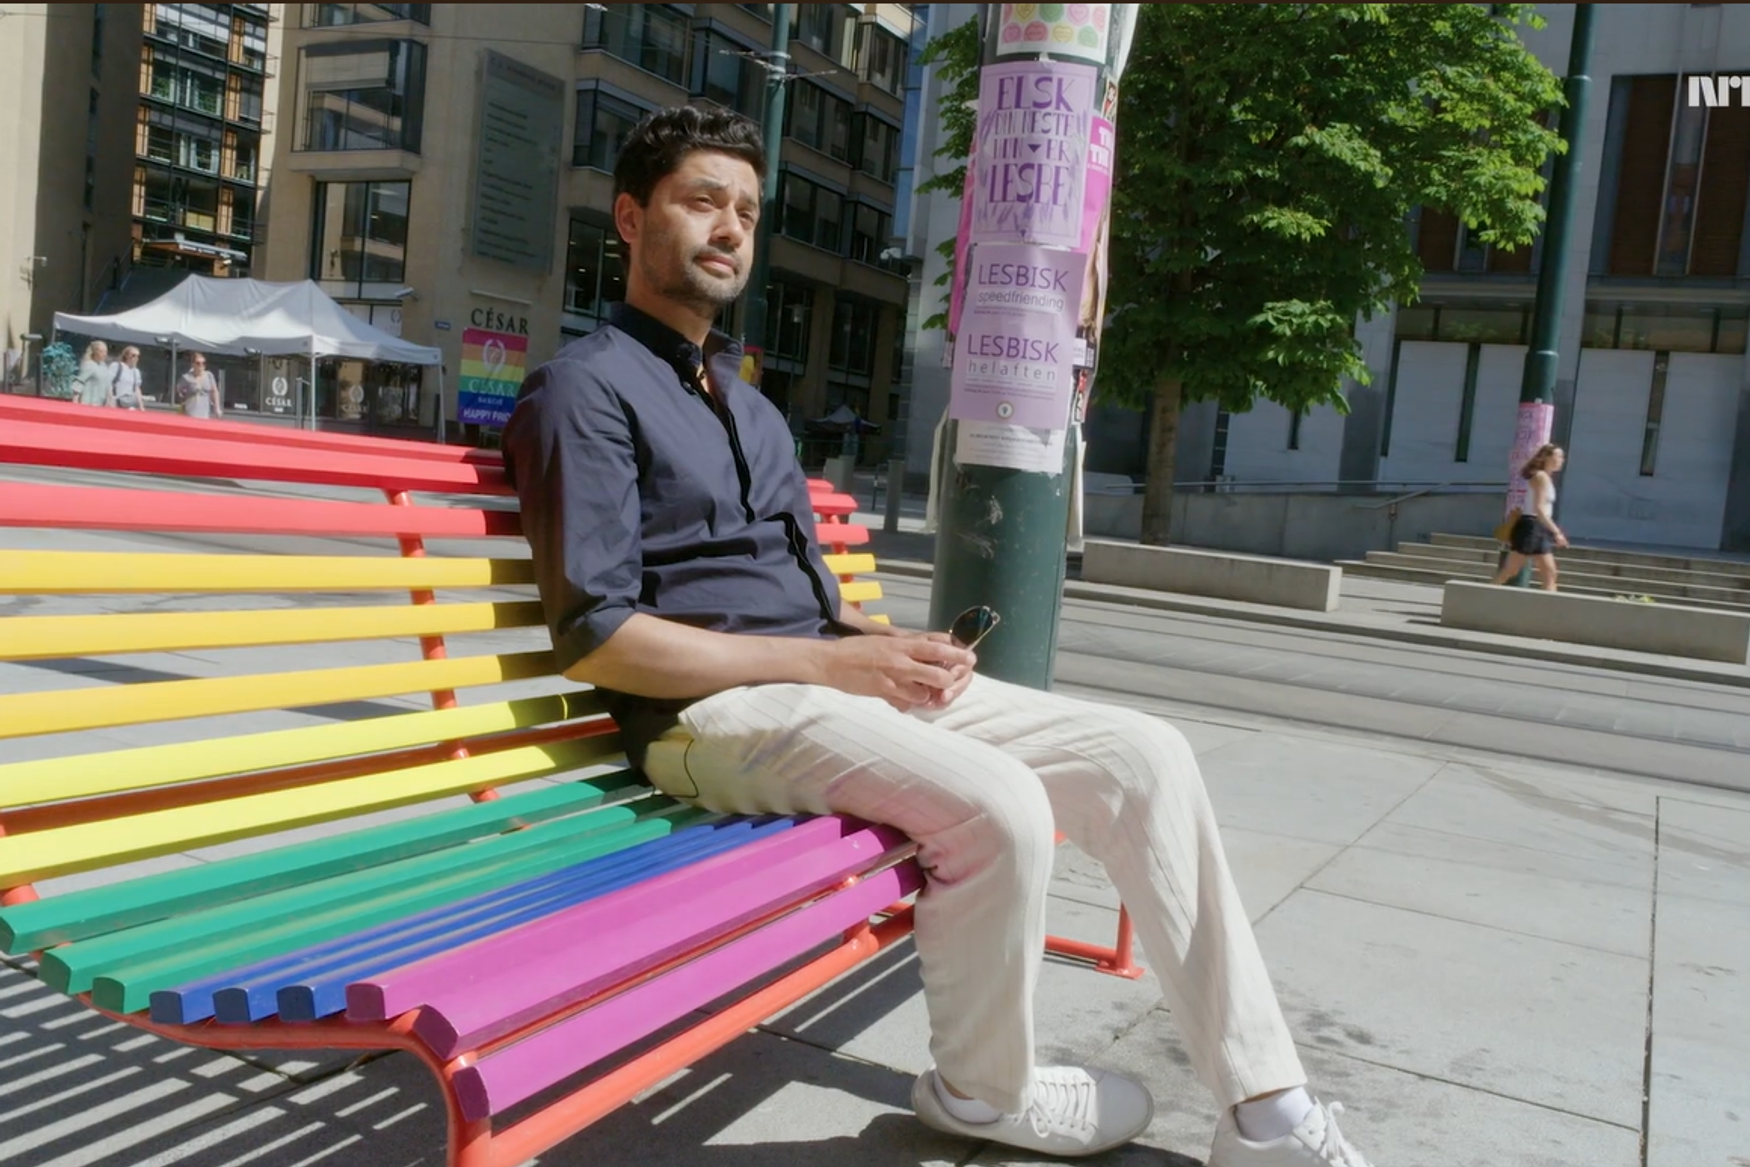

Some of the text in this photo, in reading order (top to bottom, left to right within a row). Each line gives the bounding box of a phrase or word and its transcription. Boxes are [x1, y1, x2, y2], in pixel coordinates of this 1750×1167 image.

[996, 75, 1075, 112] ELSK
[1046, 138, 1070, 163] ER
[978, 263, 1070, 293] LESBISK
[978, 290, 1065, 311] speedfriending
[471, 307, 529, 335] CÉSAR
[967, 334, 1059, 363] LESBISK
[968, 360, 1056, 381] helaften
[463, 408, 491, 420] HAPPY
